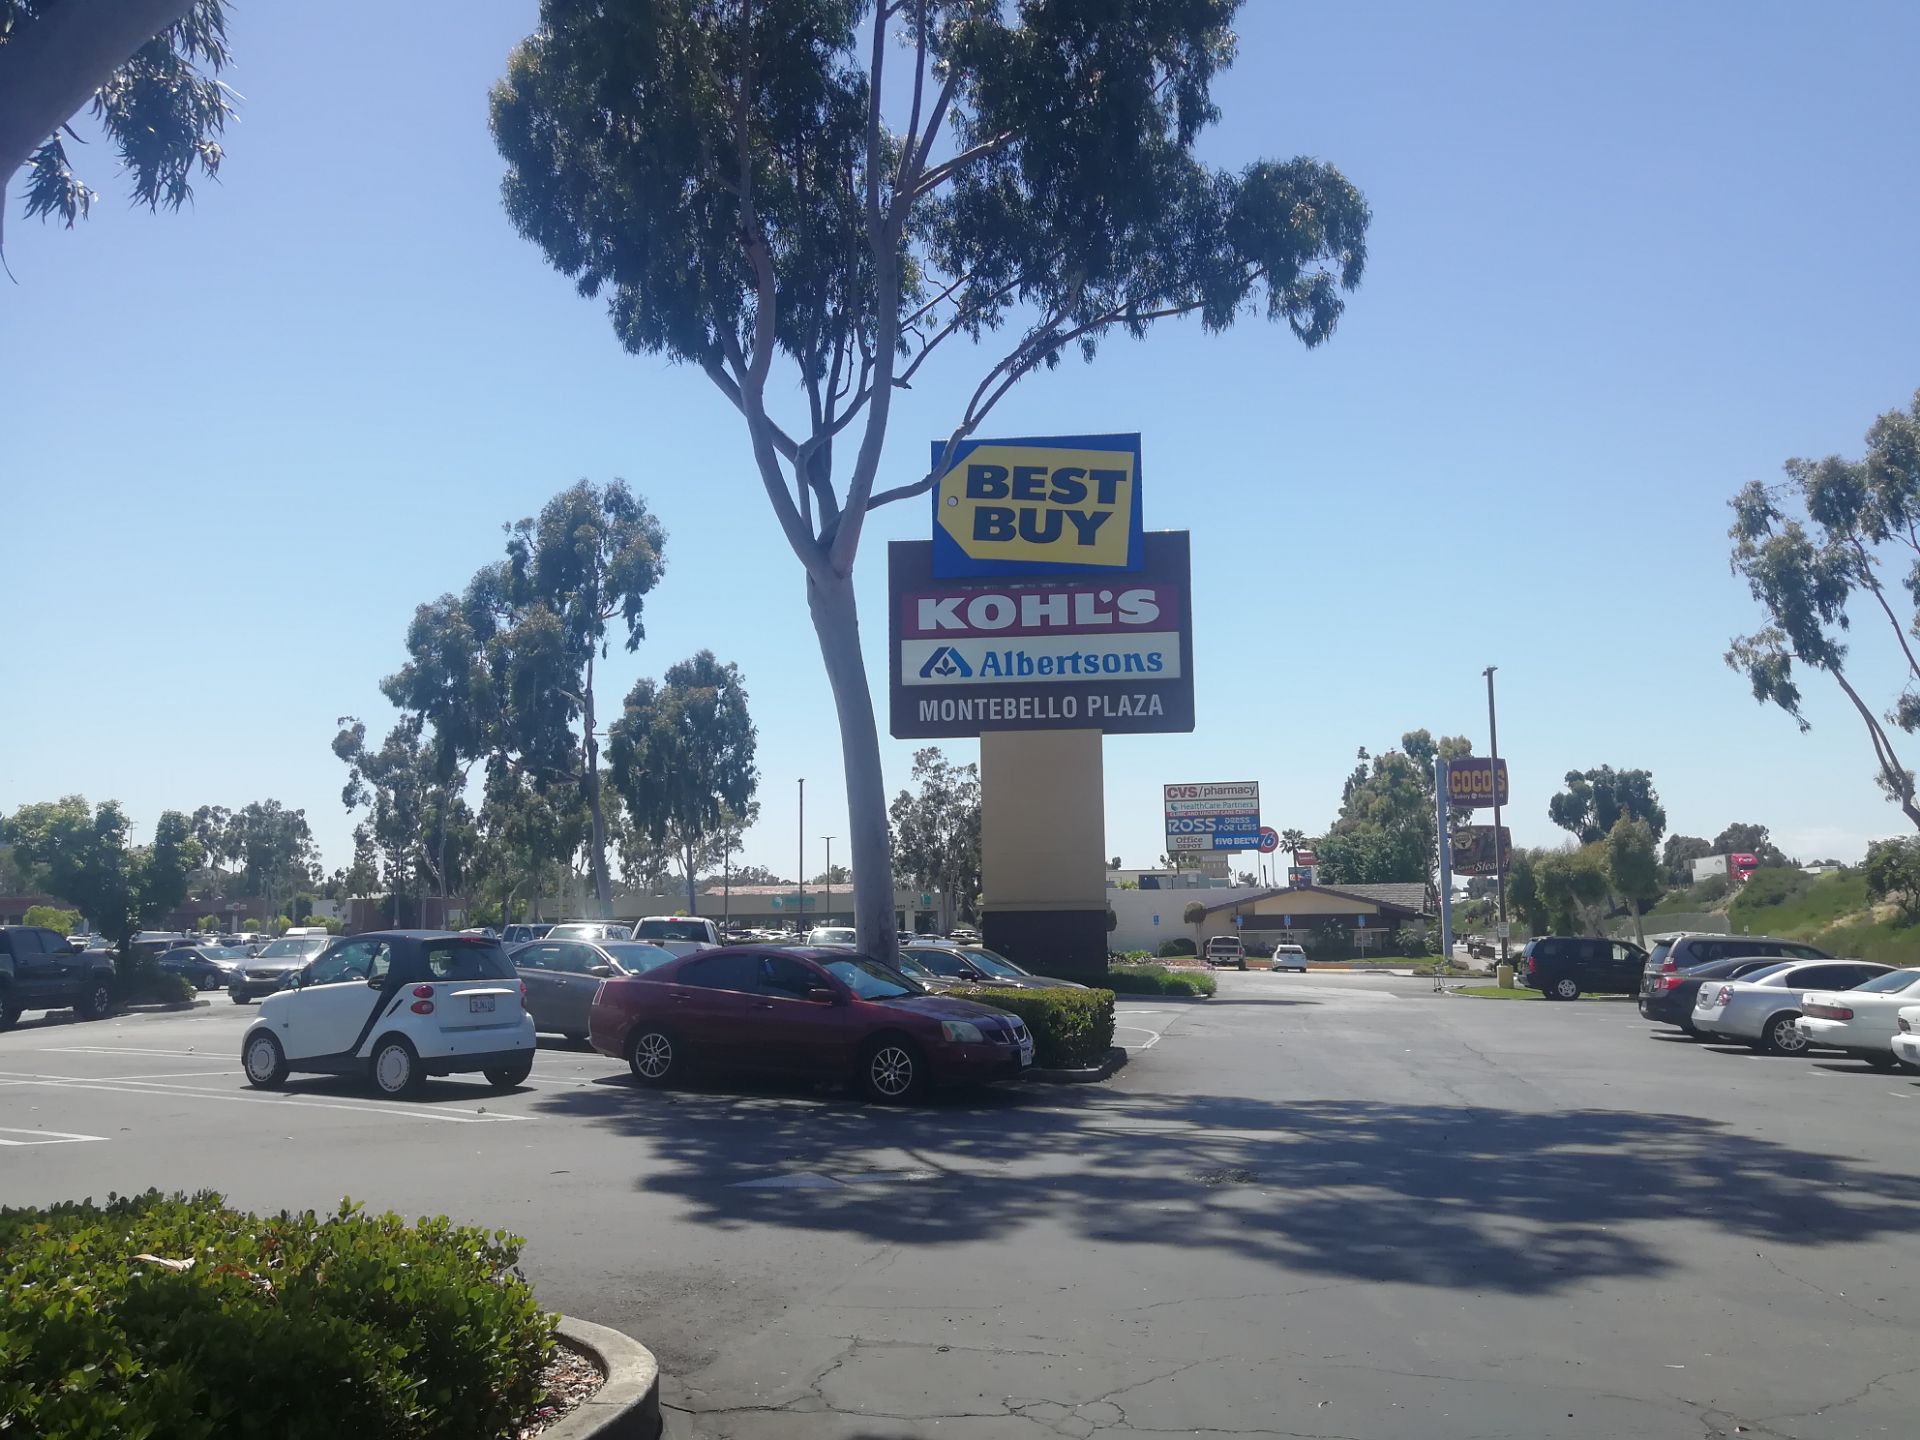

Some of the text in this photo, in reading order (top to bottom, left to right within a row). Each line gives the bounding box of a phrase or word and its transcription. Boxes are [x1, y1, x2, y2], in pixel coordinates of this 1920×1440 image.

[966, 464, 1127, 505] BEST
[973, 506, 1113, 546] BUY
[918, 589, 1160, 630] KOHL'S
[979, 650, 1163, 678] Albertsons
[919, 694, 1163, 721] MONTEBELLO PLAZA
[1451, 770, 1506, 793] COCOS
[1223, 800, 1254, 809] Partners
[1168, 818, 1216, 832] ROSS
[1176, 836, 1203, 844] Office
